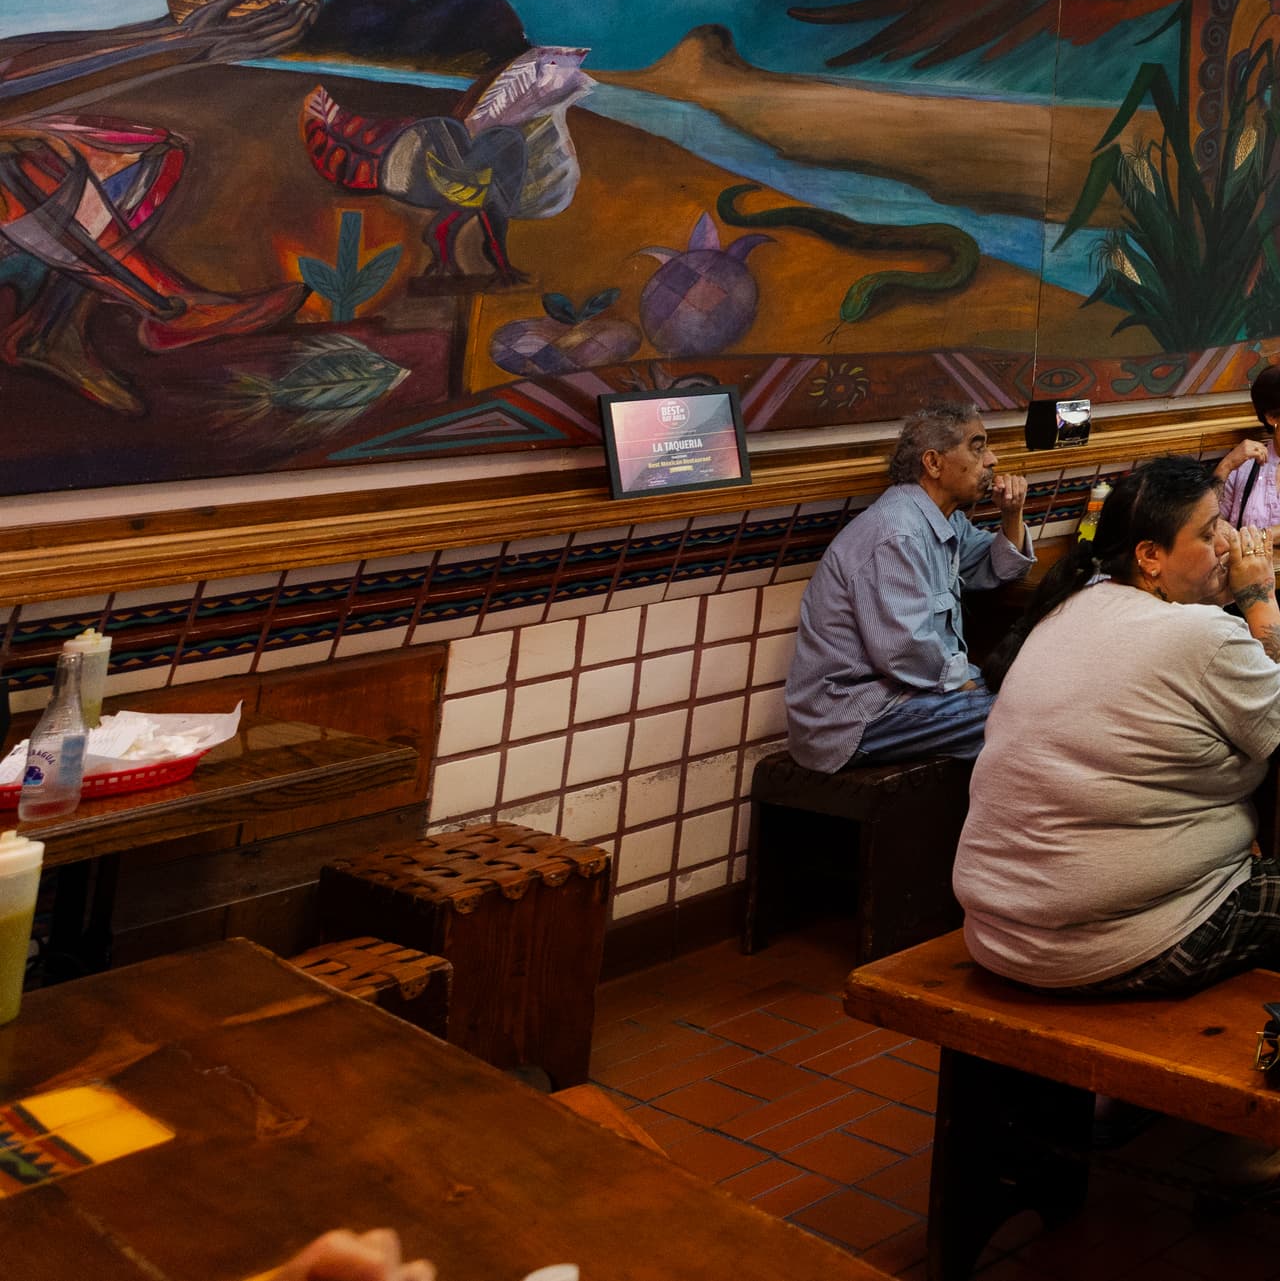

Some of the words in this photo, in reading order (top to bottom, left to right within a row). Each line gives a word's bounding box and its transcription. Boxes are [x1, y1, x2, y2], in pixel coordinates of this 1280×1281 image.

[661, 406, 681, 416] BEST
[652, 443, 663, 453] LA
[664, 438, 703, 452] TAQUERIA
